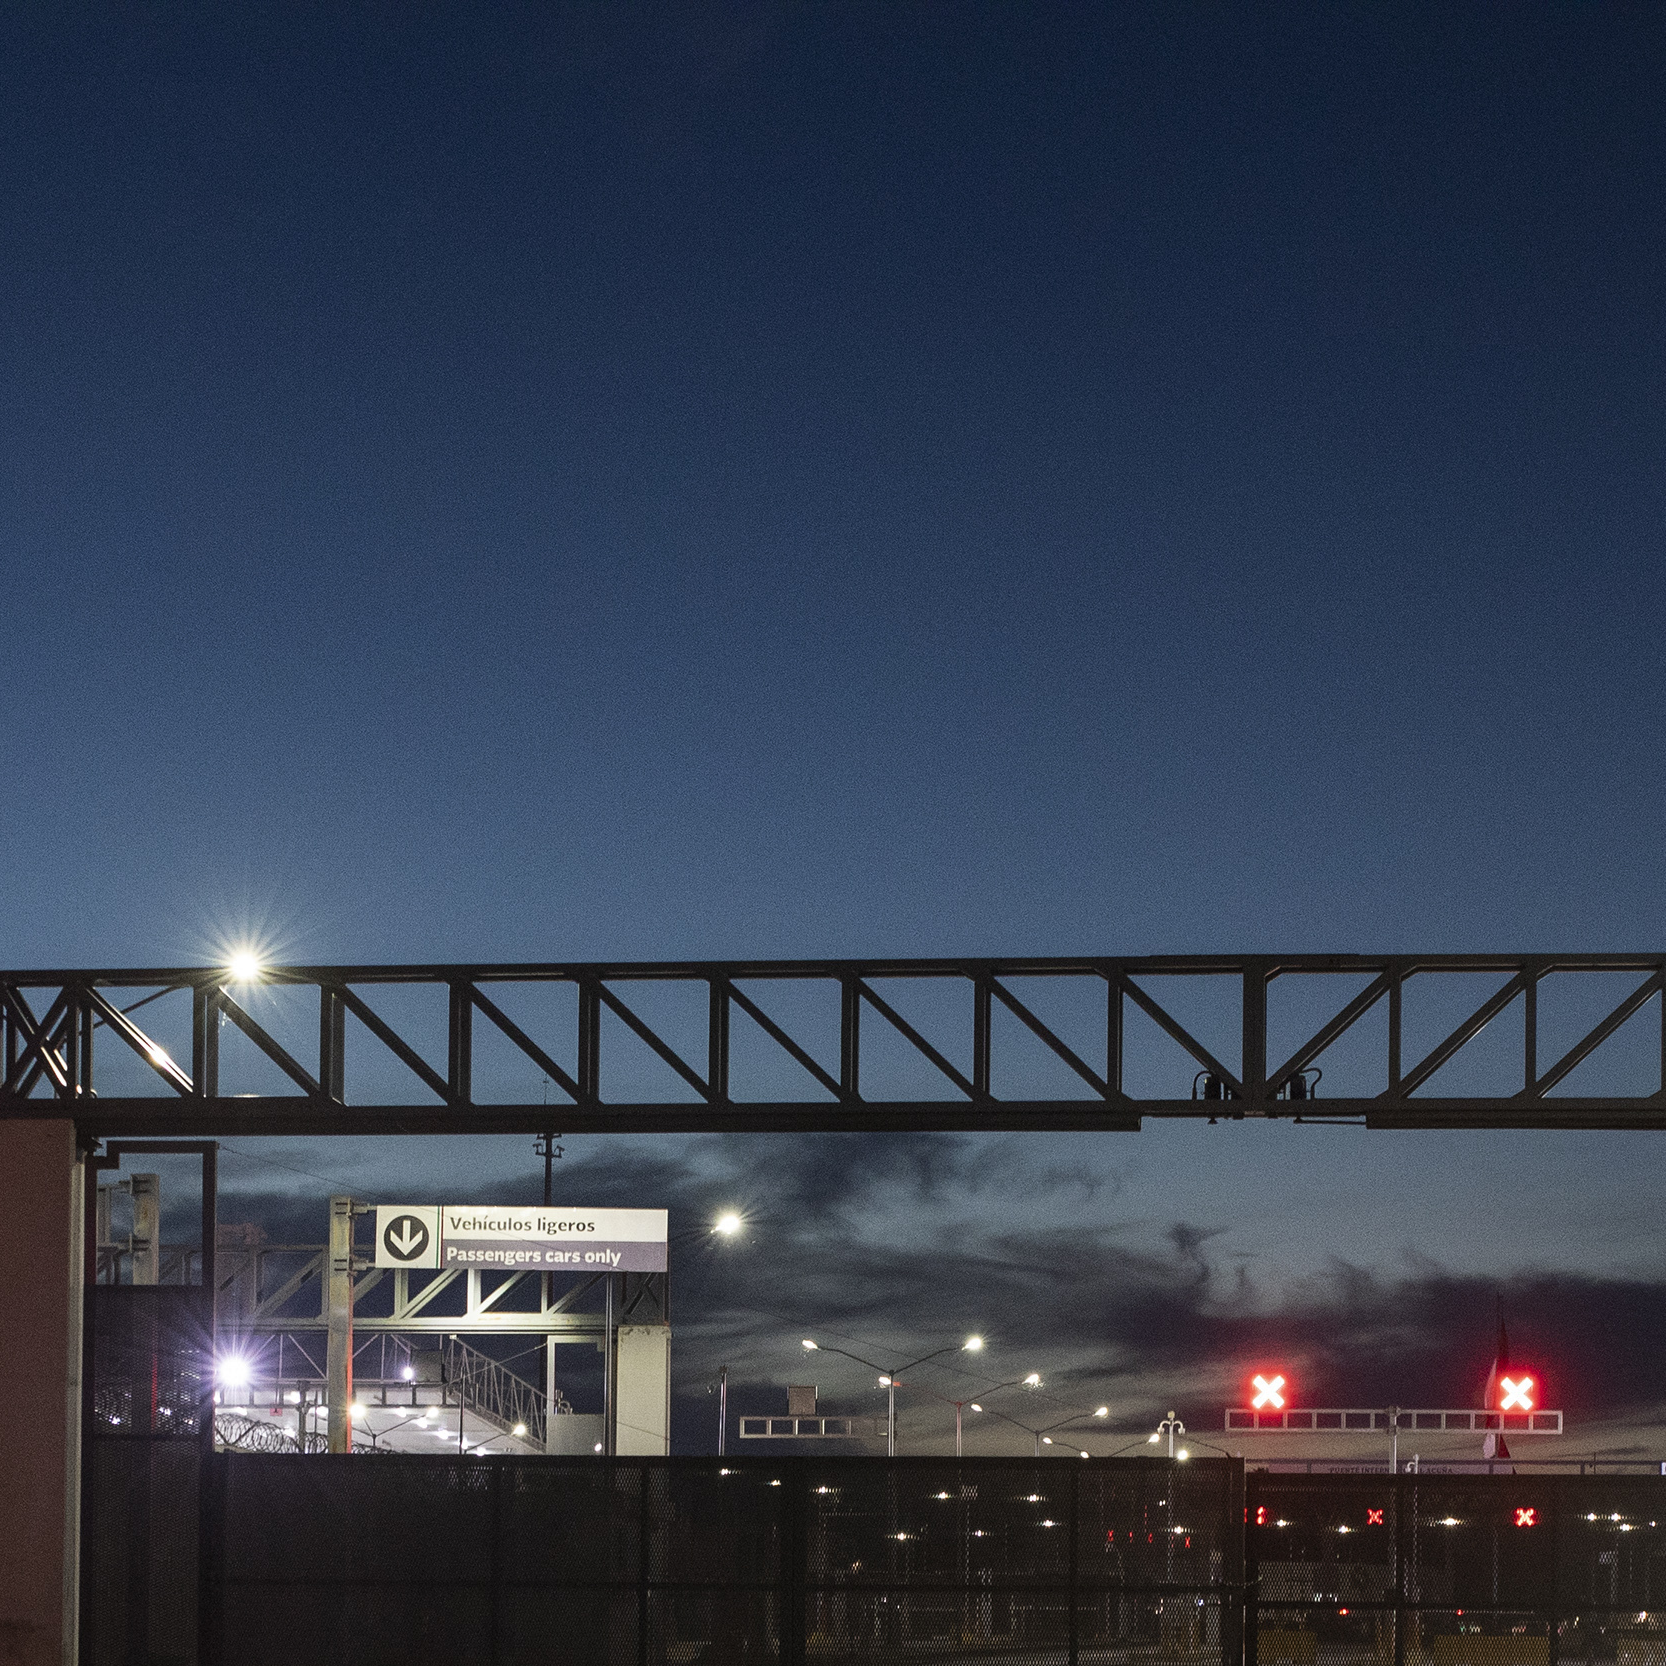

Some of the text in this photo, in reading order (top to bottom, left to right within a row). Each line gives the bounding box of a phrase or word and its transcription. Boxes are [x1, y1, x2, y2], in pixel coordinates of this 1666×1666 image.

[450, 1214, 596, 1236] Vehículos ligeros
[446, 1247, 622, 1267] Passengers cars only
